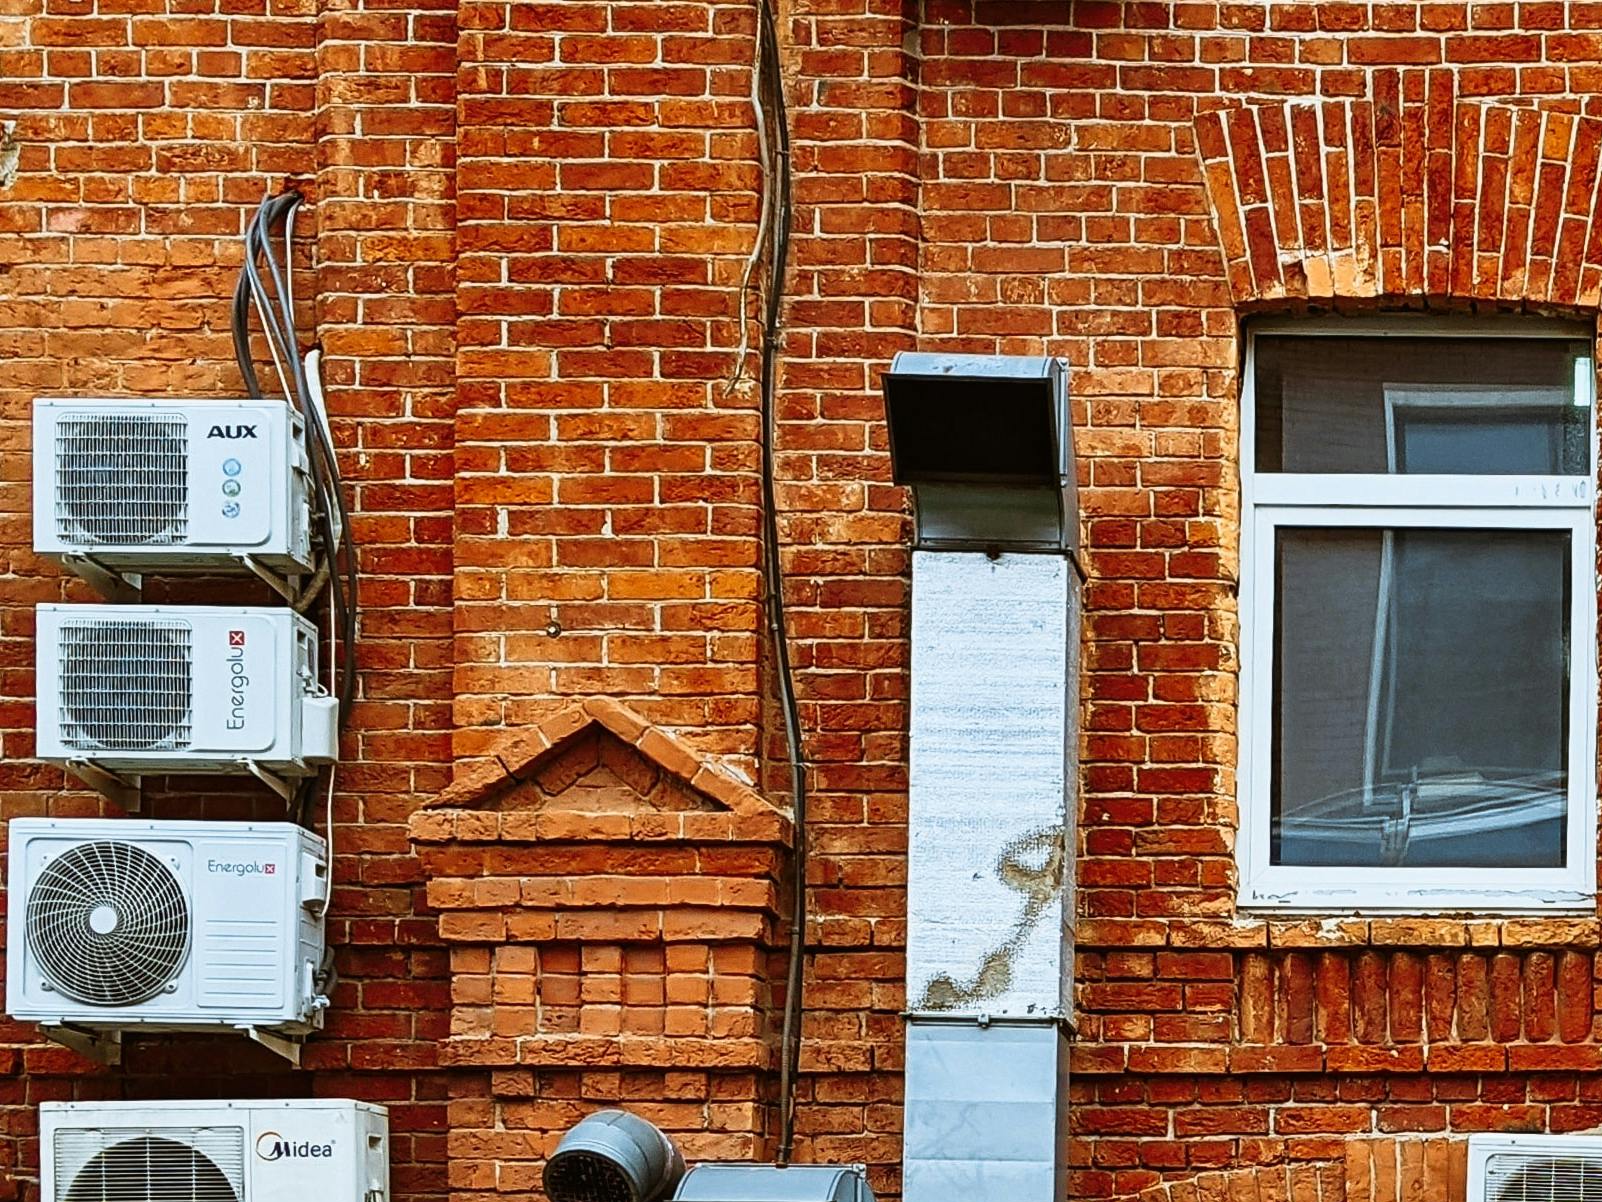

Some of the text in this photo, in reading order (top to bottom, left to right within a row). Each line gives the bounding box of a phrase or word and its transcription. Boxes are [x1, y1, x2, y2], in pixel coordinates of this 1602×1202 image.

[206, 424, 258, 440] AUX
[225, 630, 250, 730] Energolux
[207, 859, 276, 877] Energolux
[255, 1131, 333, 1161] Midea
